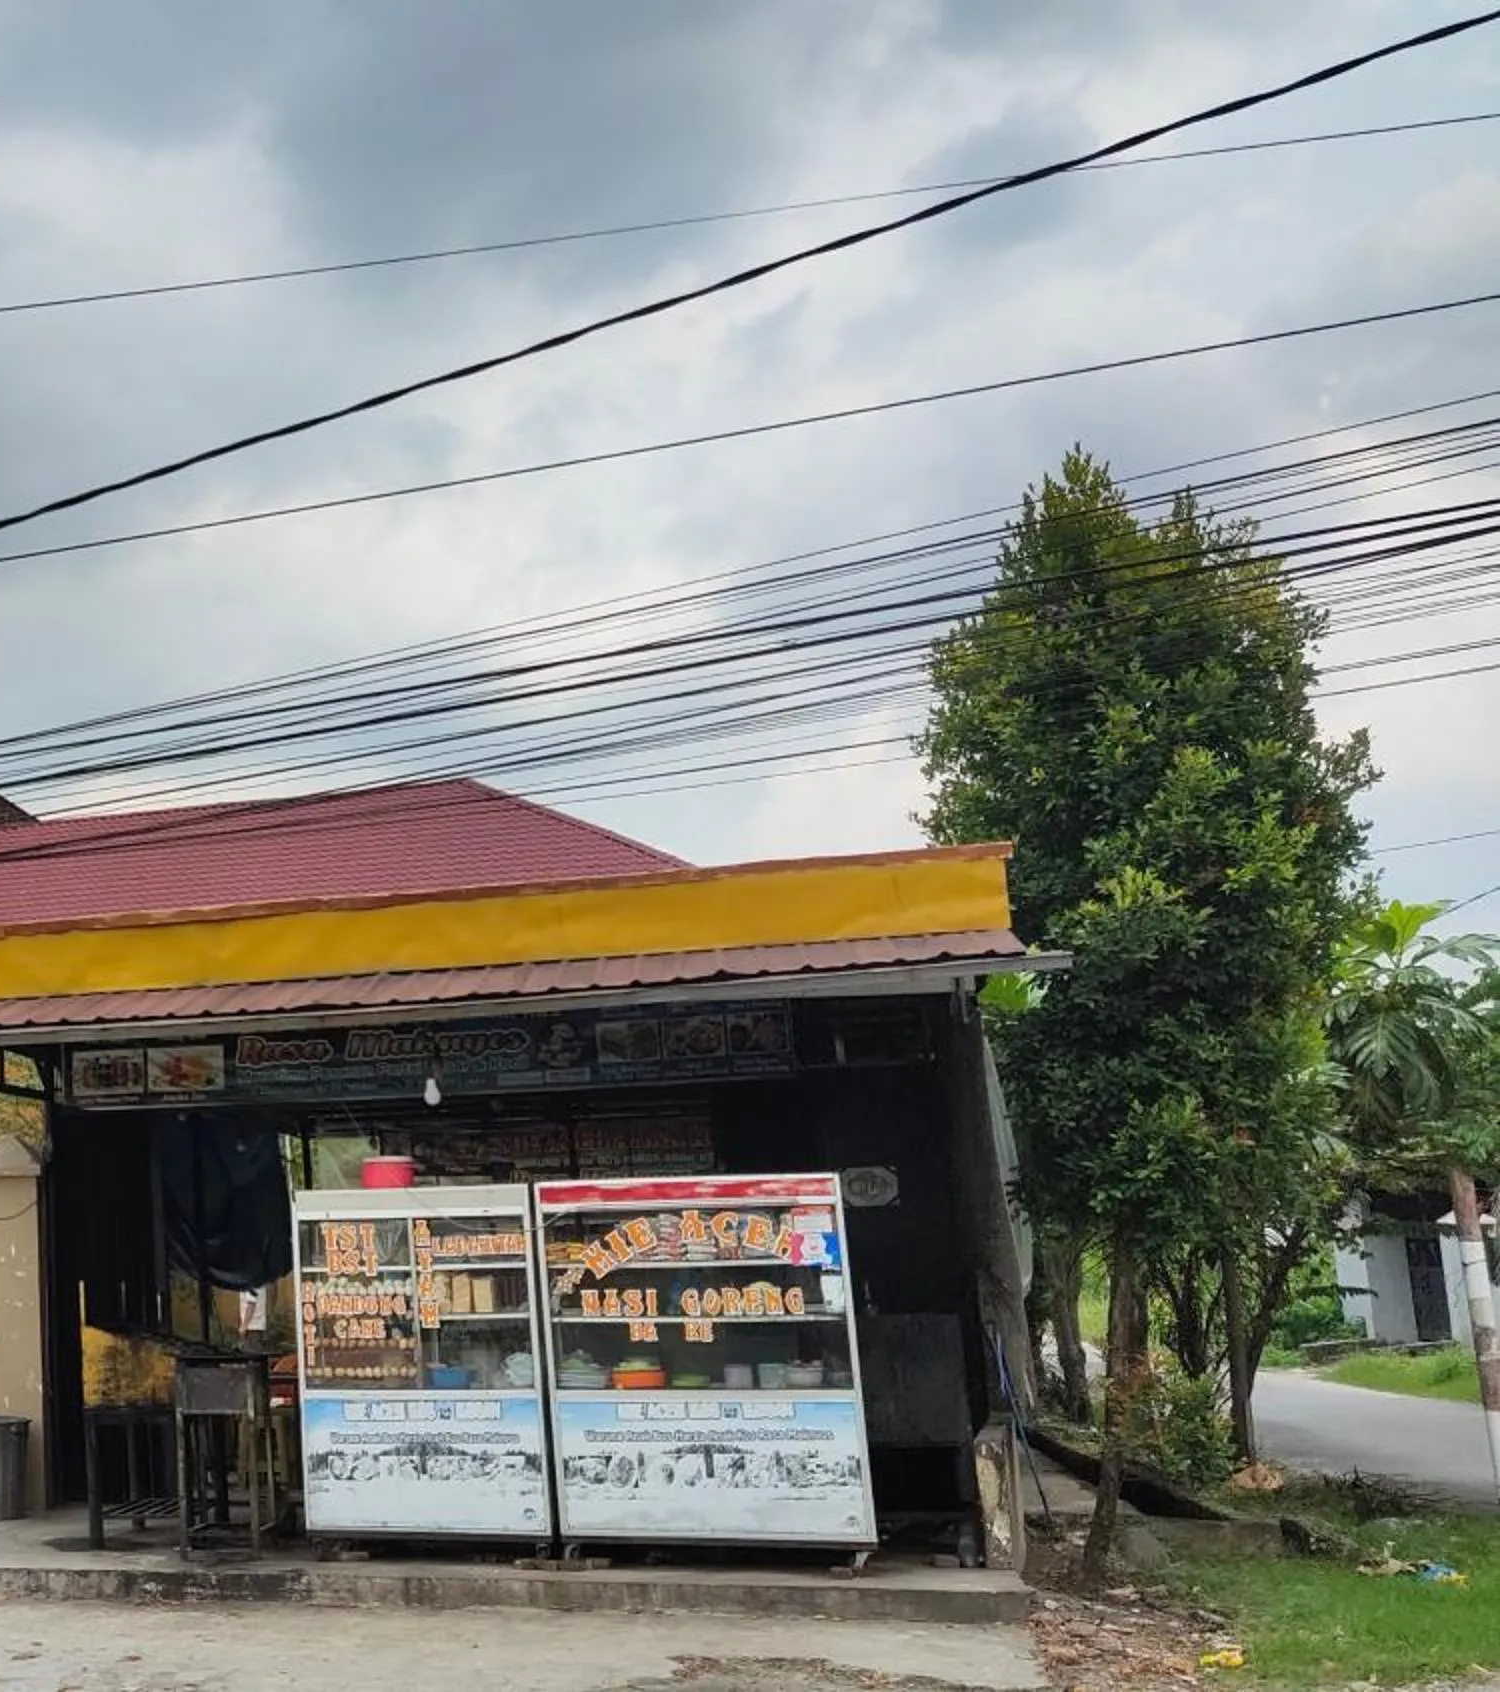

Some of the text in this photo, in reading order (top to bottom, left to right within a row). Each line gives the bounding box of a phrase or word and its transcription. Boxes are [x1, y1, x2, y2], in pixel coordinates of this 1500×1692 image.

[236, 1036, 334, 1066] Rasa
[580, 1216, 657, 1280] MIE
[581, 1286, 805, 1317] NASI GORENG
[333, 1317, 387, 1339] CANE
